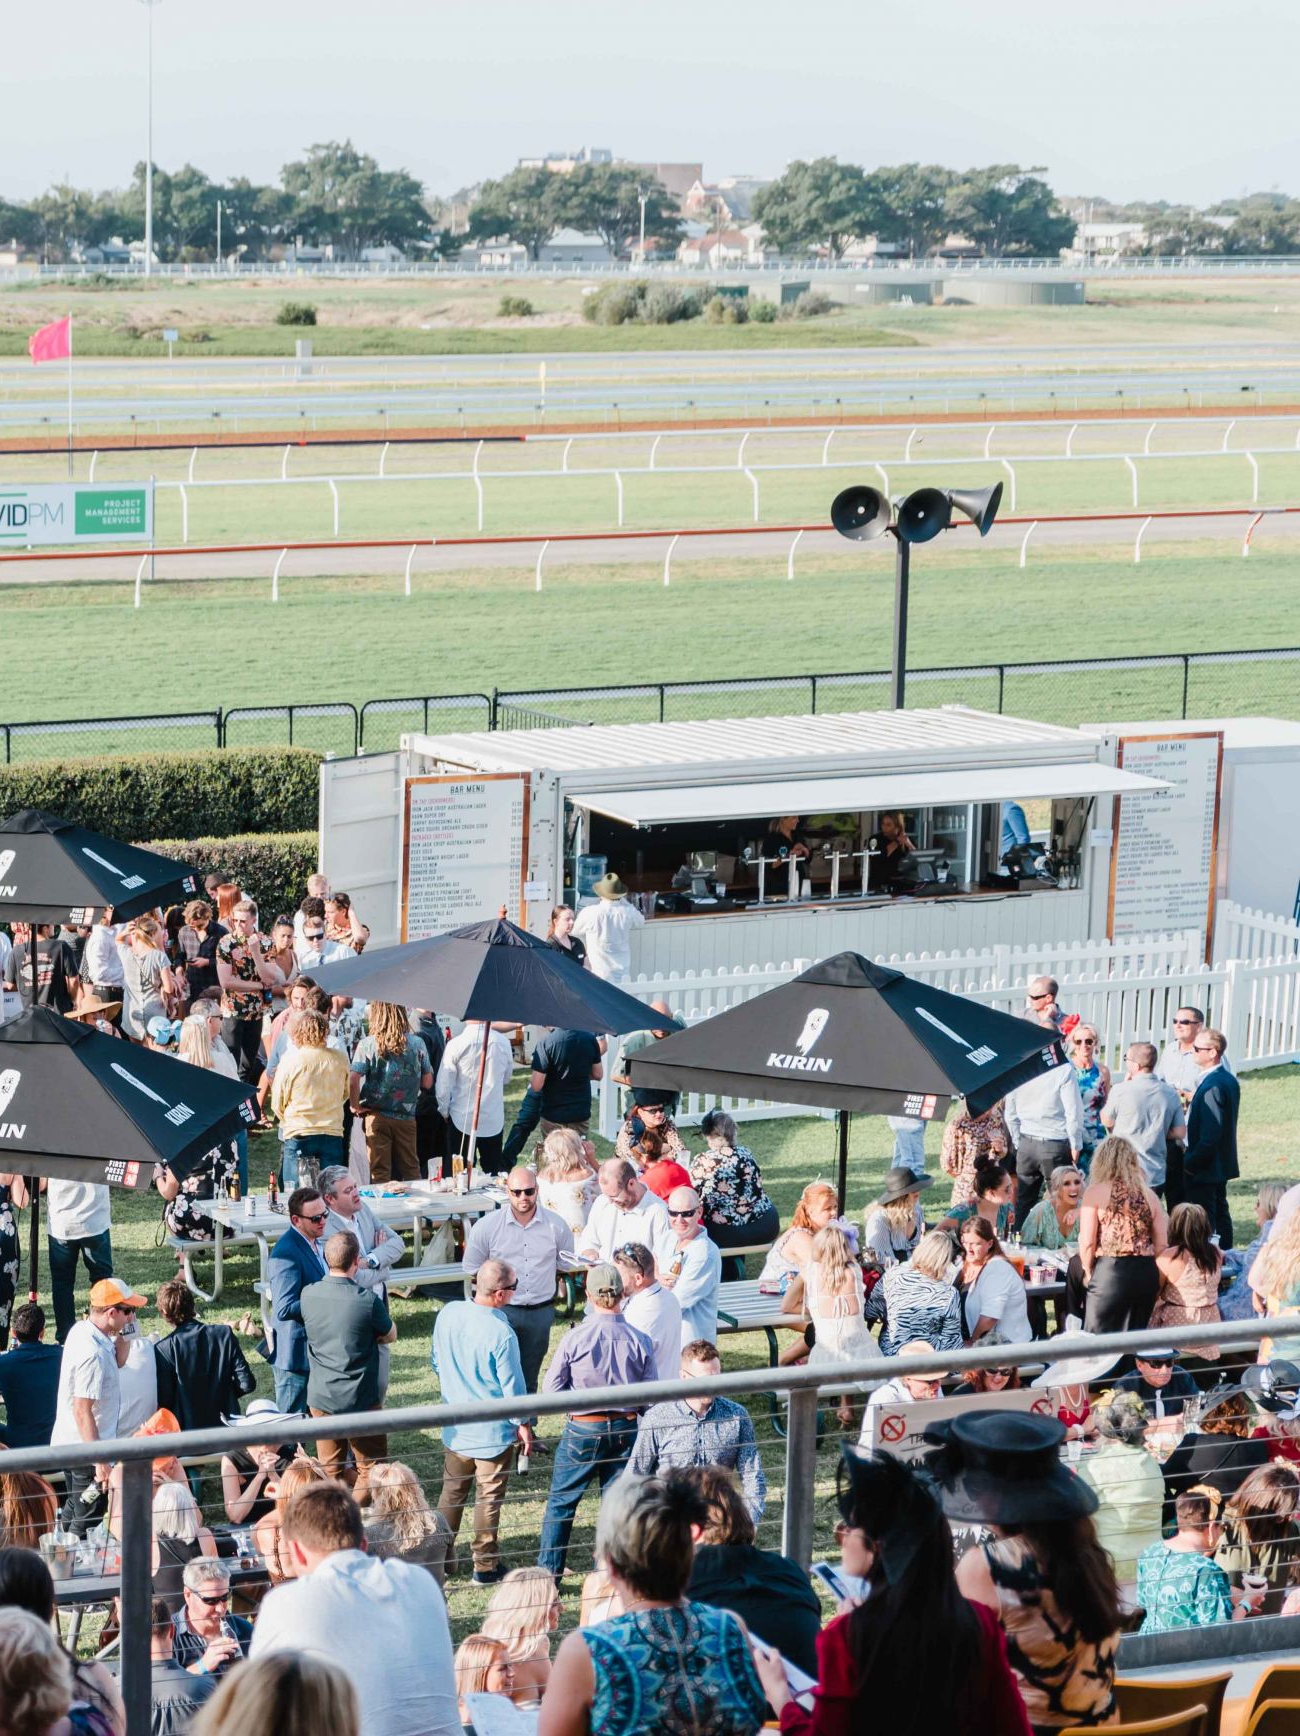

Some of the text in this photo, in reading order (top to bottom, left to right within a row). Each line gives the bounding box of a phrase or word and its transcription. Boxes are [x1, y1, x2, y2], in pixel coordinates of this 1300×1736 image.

[104, 499, 141, 508] PROJECT
[85, 508, 141, 517] MANAGEMENT
[102, 516, 141, 525] SERVICES
[450, 784, 485, 794] BAR MENU
[766, 1052, 833, 1073] KIRIN
[907, 1094, 924, 1103] FIRST
[164, 1102, 195, 1126] KIRIN
[108, 1160, 126, 1168] FIRST
[104, 1167, 124, 1175] PRESS
[106, 1173, 123, 1182] BEER
